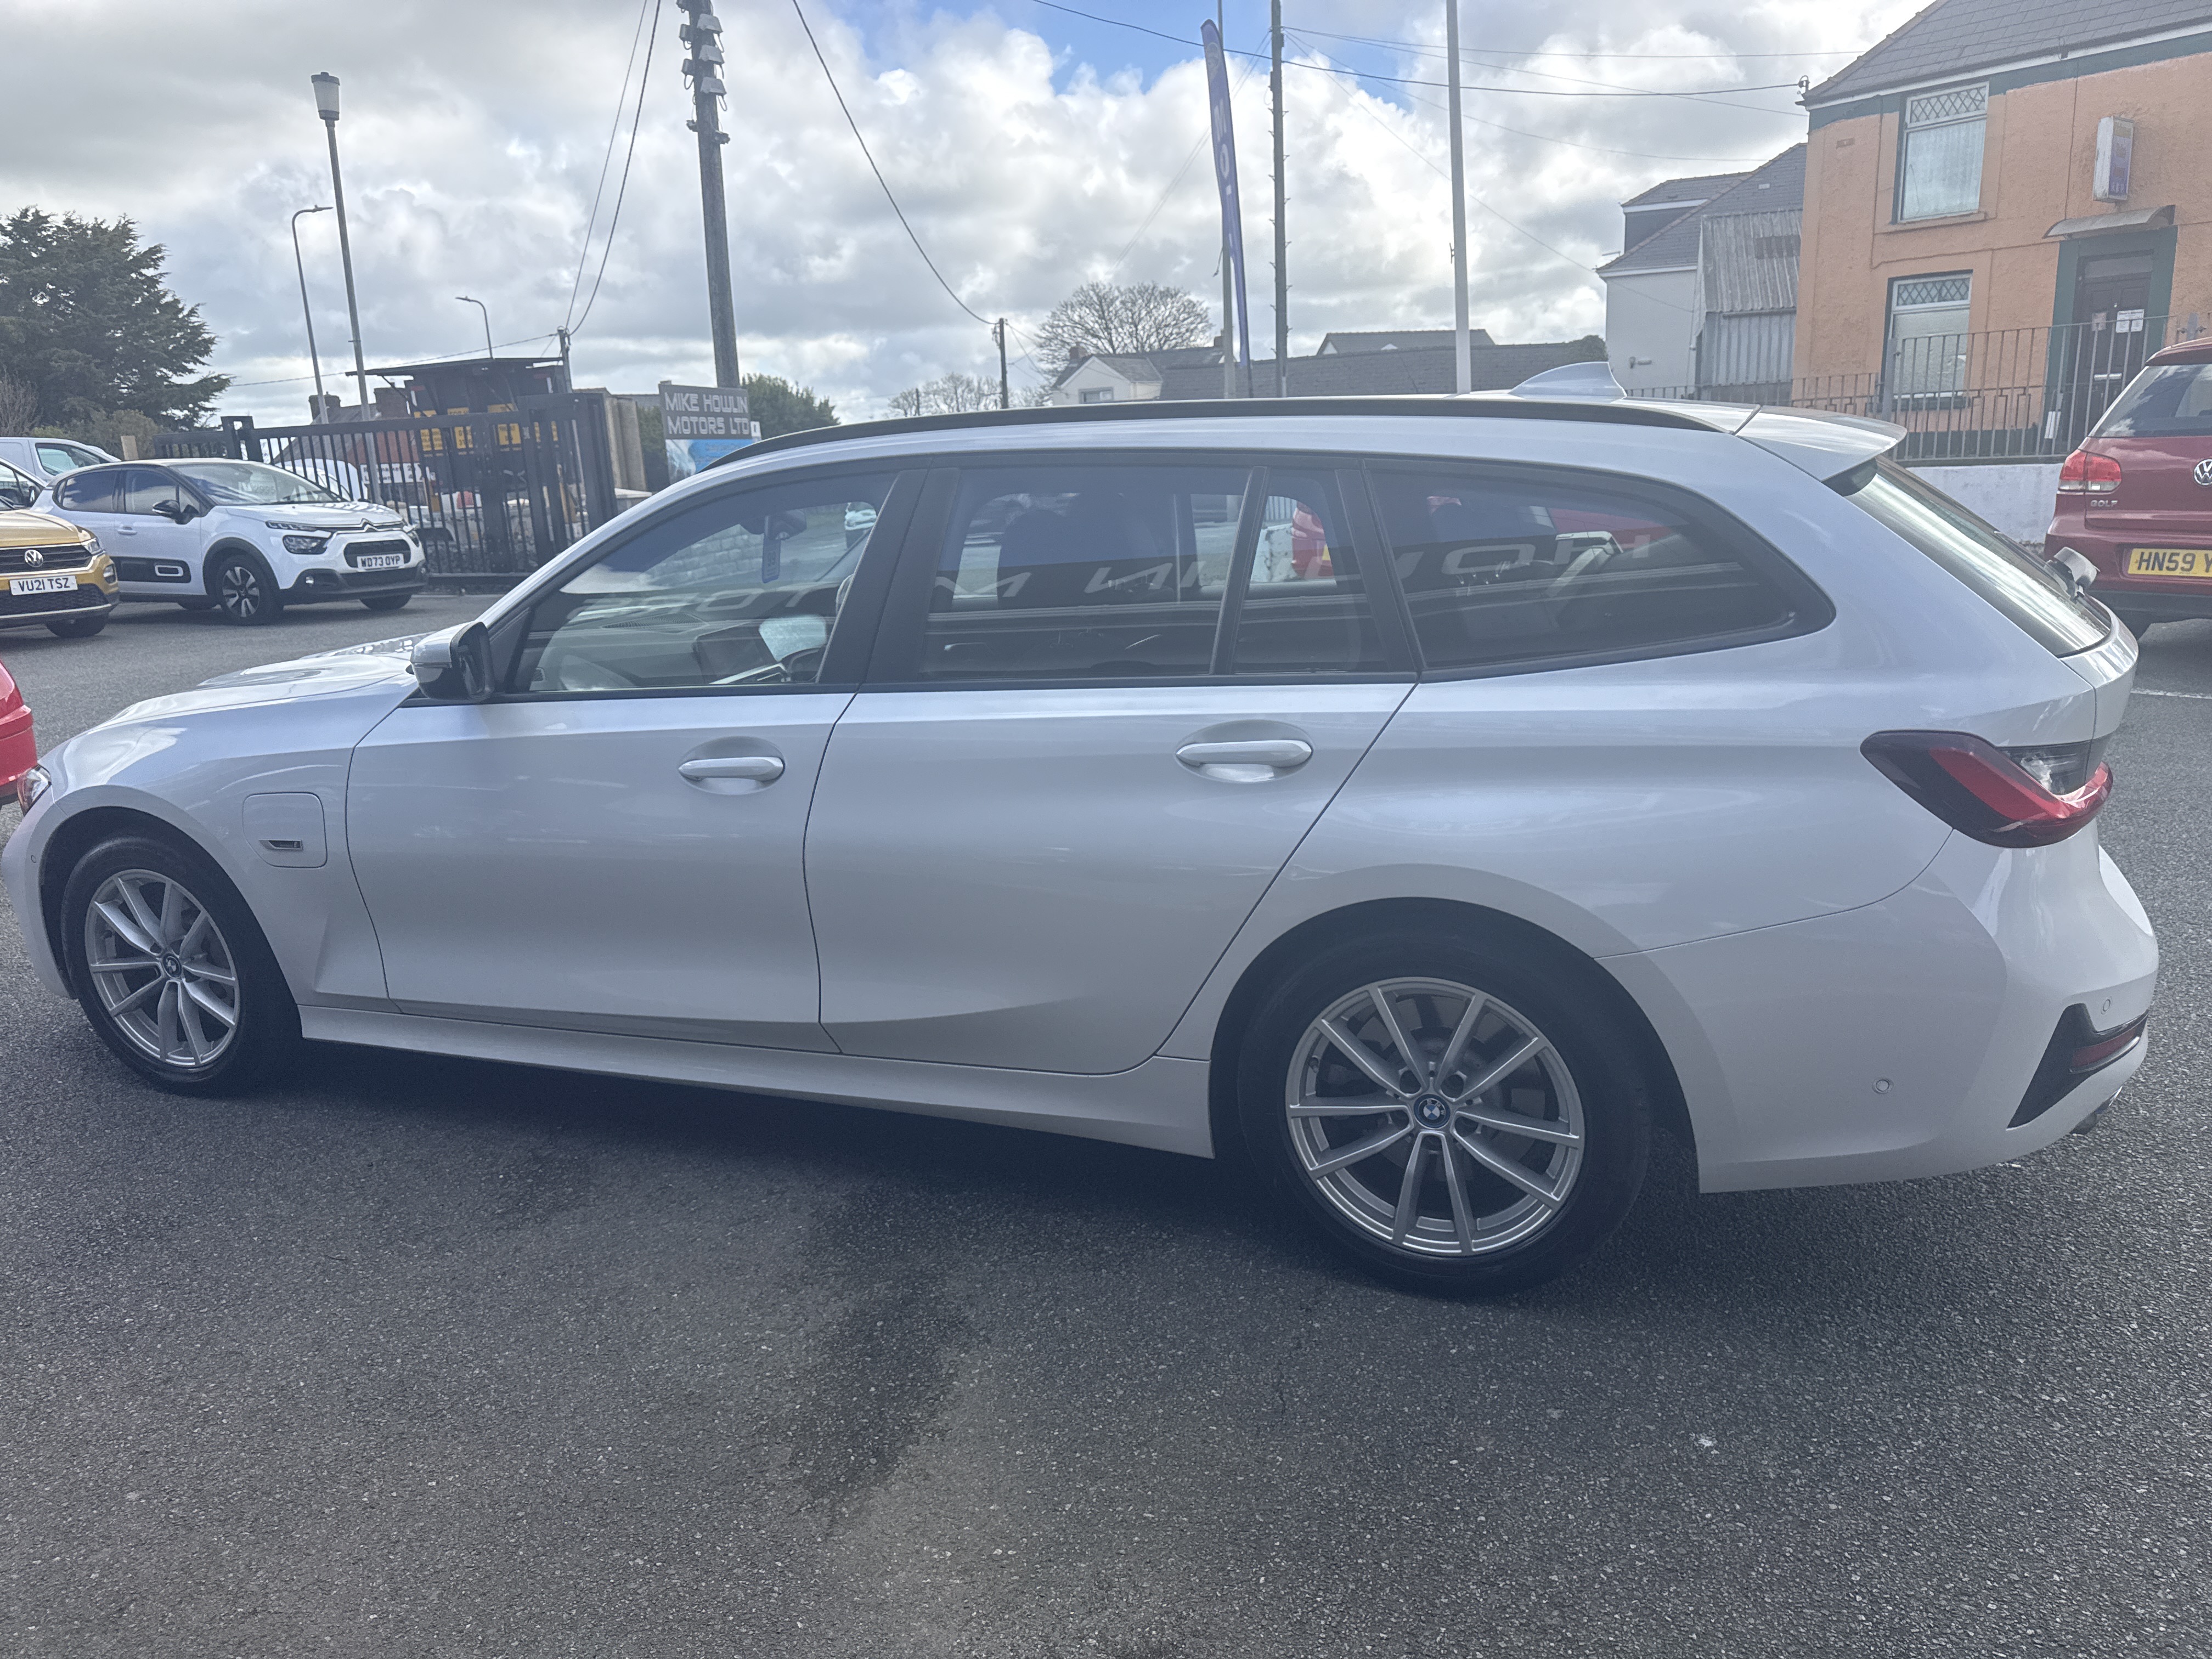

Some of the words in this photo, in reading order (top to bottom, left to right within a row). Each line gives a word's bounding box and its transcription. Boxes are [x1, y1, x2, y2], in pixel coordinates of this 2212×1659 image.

[664, 392, 699, 411] MIKE
[702, 394, 748, 414] HOWLIN
[667, 415, 725, 435] MOTORS
[730, 417, 749, 435] LTD
[360, 556, 383, 567] WD73
[385, 555, 400, 566] OYP
[2137, 551, 2196, 571] HN59
[18, 579, 46, 592] VU21
[47, 577, 70, 590] TSZ
